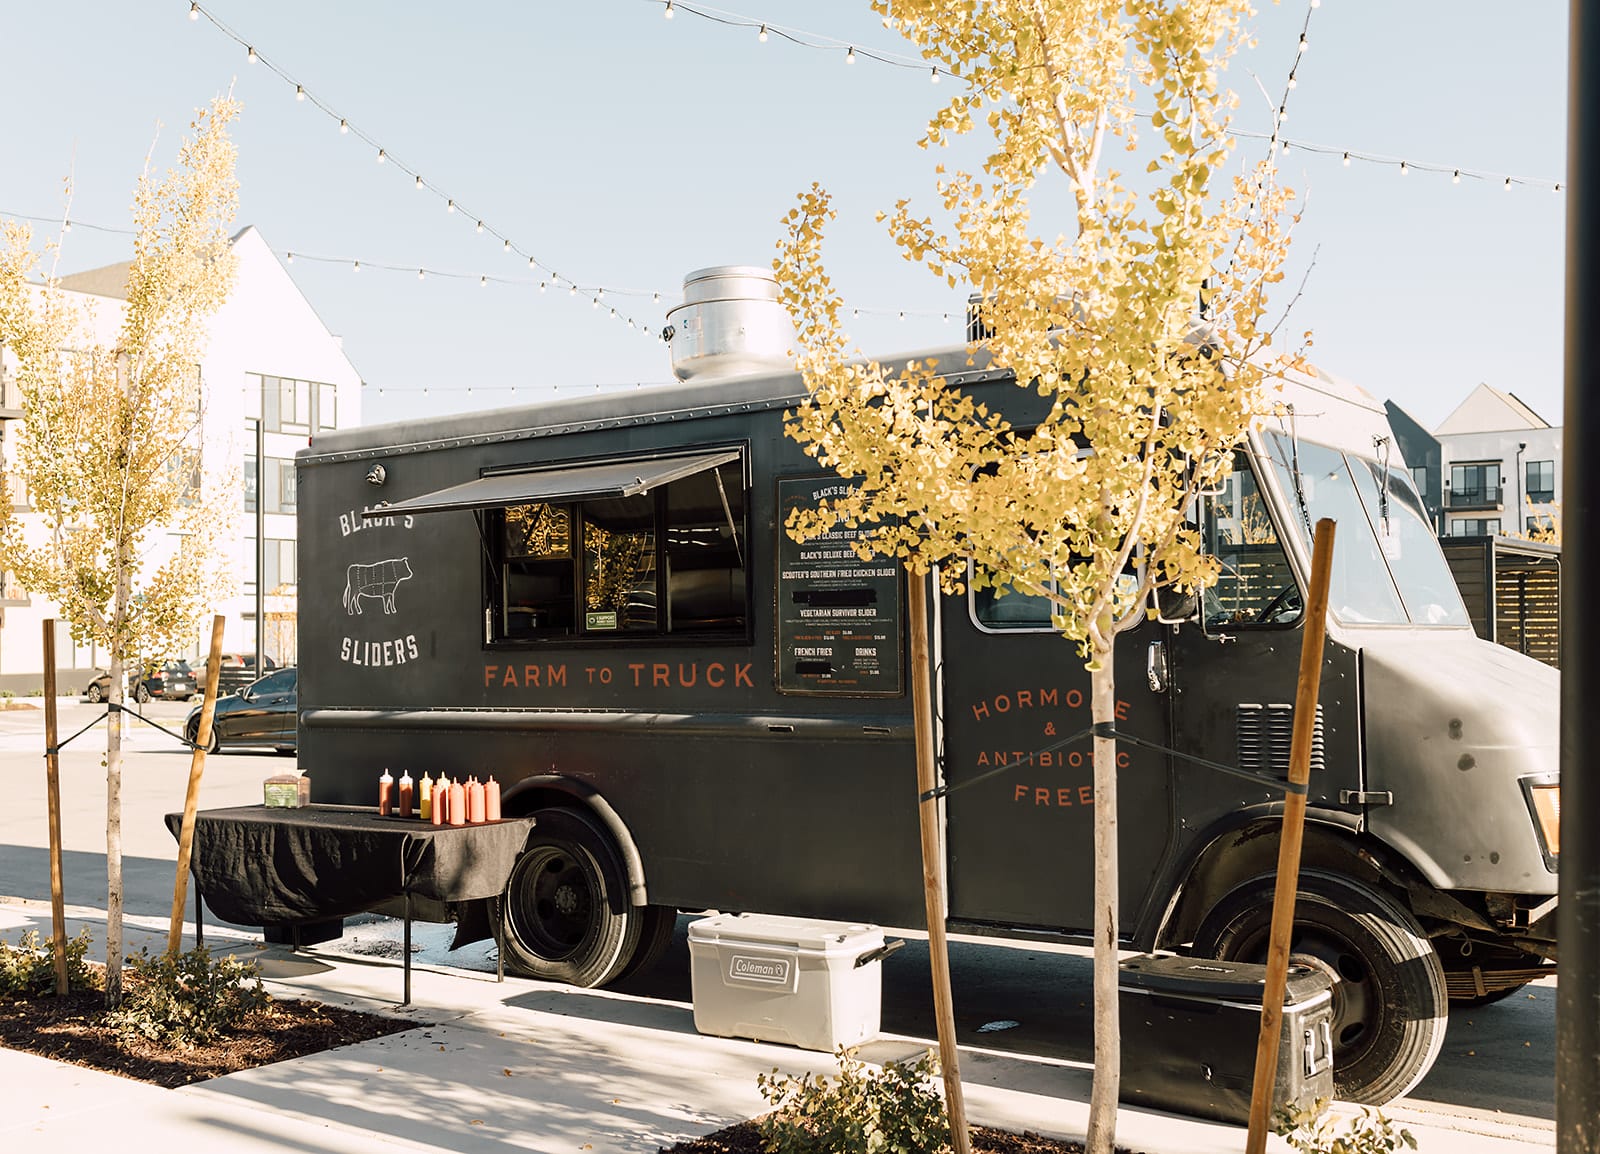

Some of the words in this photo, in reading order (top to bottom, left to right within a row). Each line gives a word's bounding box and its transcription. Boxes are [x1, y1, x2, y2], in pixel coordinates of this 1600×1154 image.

[812, 488, 838, 500] BLACK'S
[822, 532, 843, 540] CLASSIC
[844, 531, 857, 540] BEEF
[800, 551, 822, 560] BLACK'S
[823, 550, 842, 559] DELUXE
[843, 550, 856, 558] BEEF
[810, 570, 836, 578] SOUTHERN
[837, 570, 852, 578] FRIED
[853, 569, 876, 577] CHICKEN
[877, 568, 896, 577] SLIDER
[800, 609, 831, 618] VEGETARIAN
[832, 609, 857, 617] SURVIVOR
[858, 608, 877, 617] SLIDER
[340, 635, 420, 667] SLIDERS
[794, 648, 815, 657] FRENCH
[816, 648, 832, 657] FRIES
[855, 648, 877, 657] DRINKS
[484, 665, 568, 688] FARM
[586, 667, 613, 684] TO
[628, 663, 755, 687] TRUCK
[972, 688, 1131, 722] HORMOE
[1044, 722, 1057, 736] &
[976, 752, 1131, 768] ANTIBIOTC
[1014, 784, 1095, 806] FREE
[736, 959, 773, 975] Coleman
